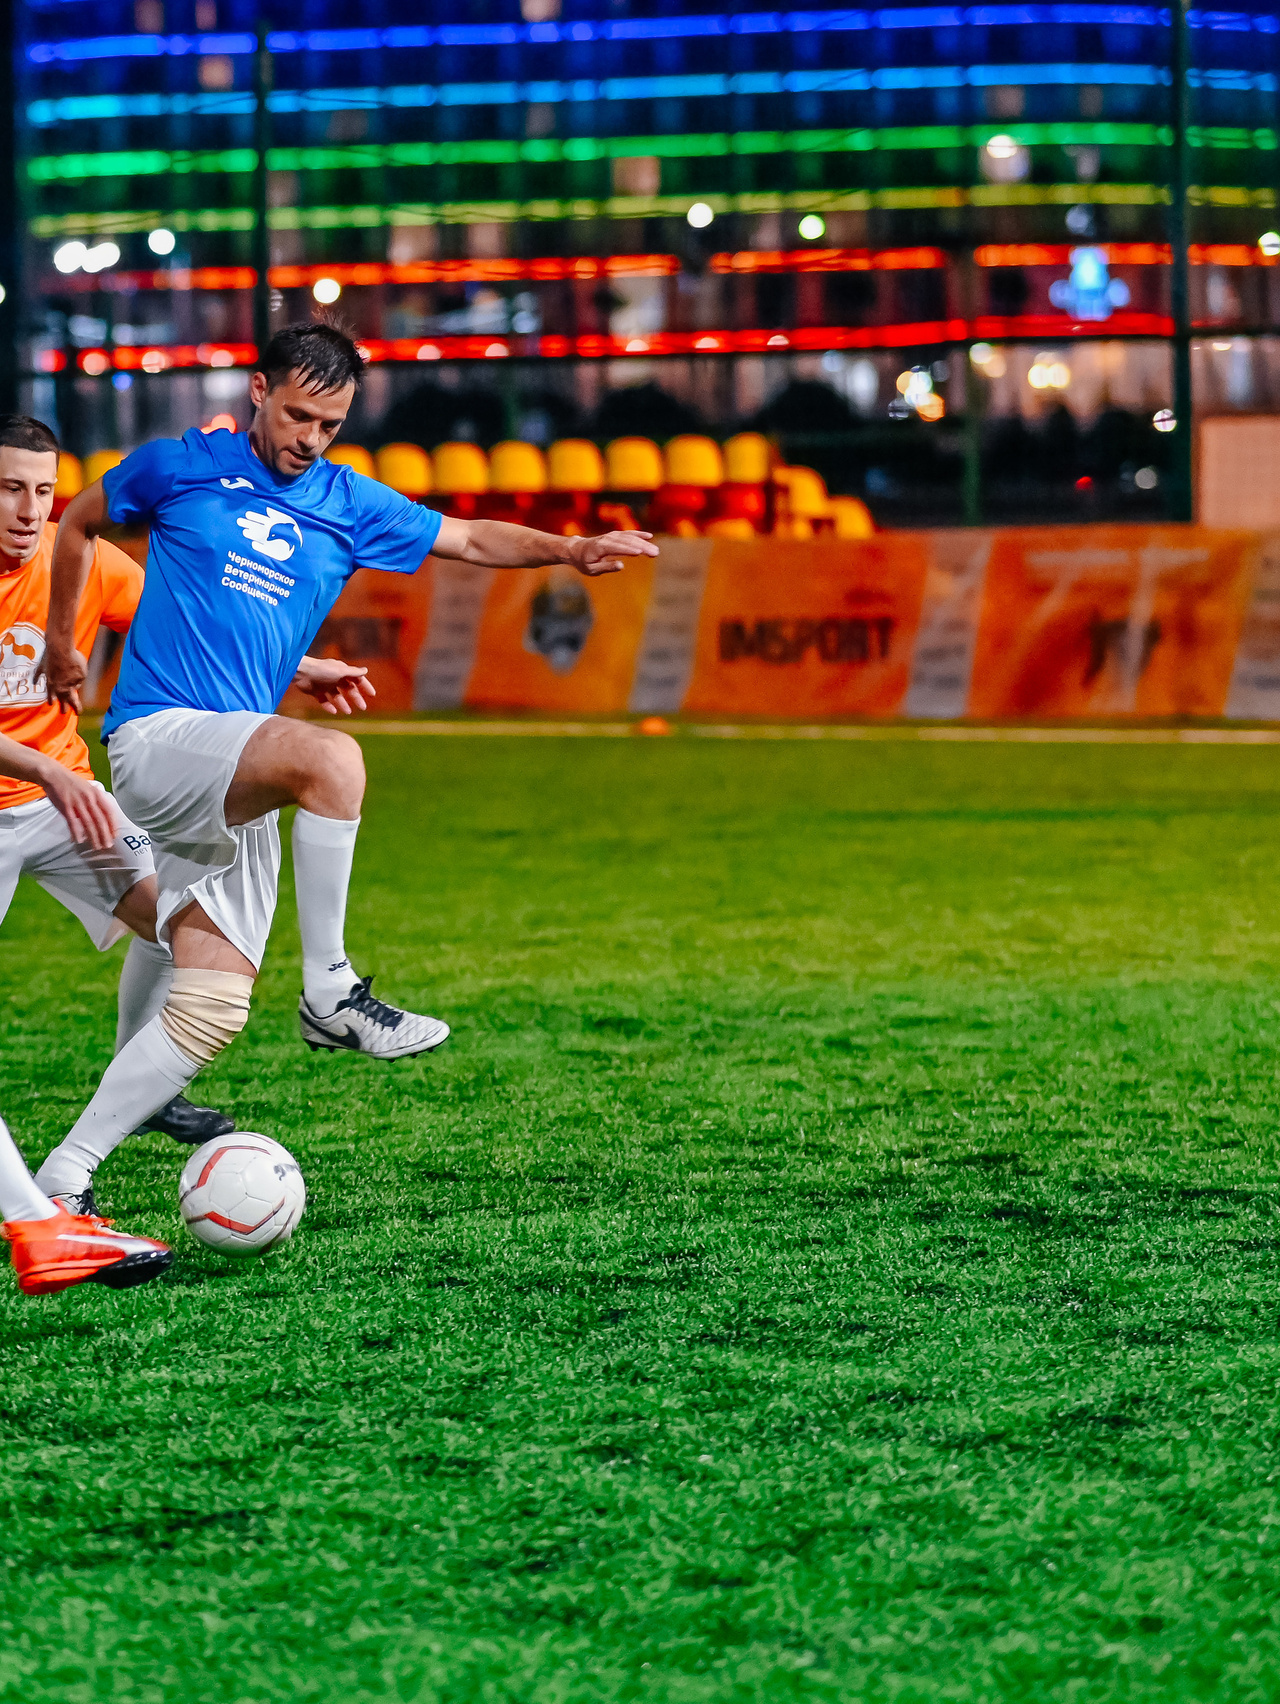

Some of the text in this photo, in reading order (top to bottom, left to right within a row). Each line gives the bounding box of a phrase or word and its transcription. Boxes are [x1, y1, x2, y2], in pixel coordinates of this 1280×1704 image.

[223, 563, 291, 599] Ветеринарное
[227, 550, 296, 587] Черноморское
[221, 576, 279, 607] Сообщество
